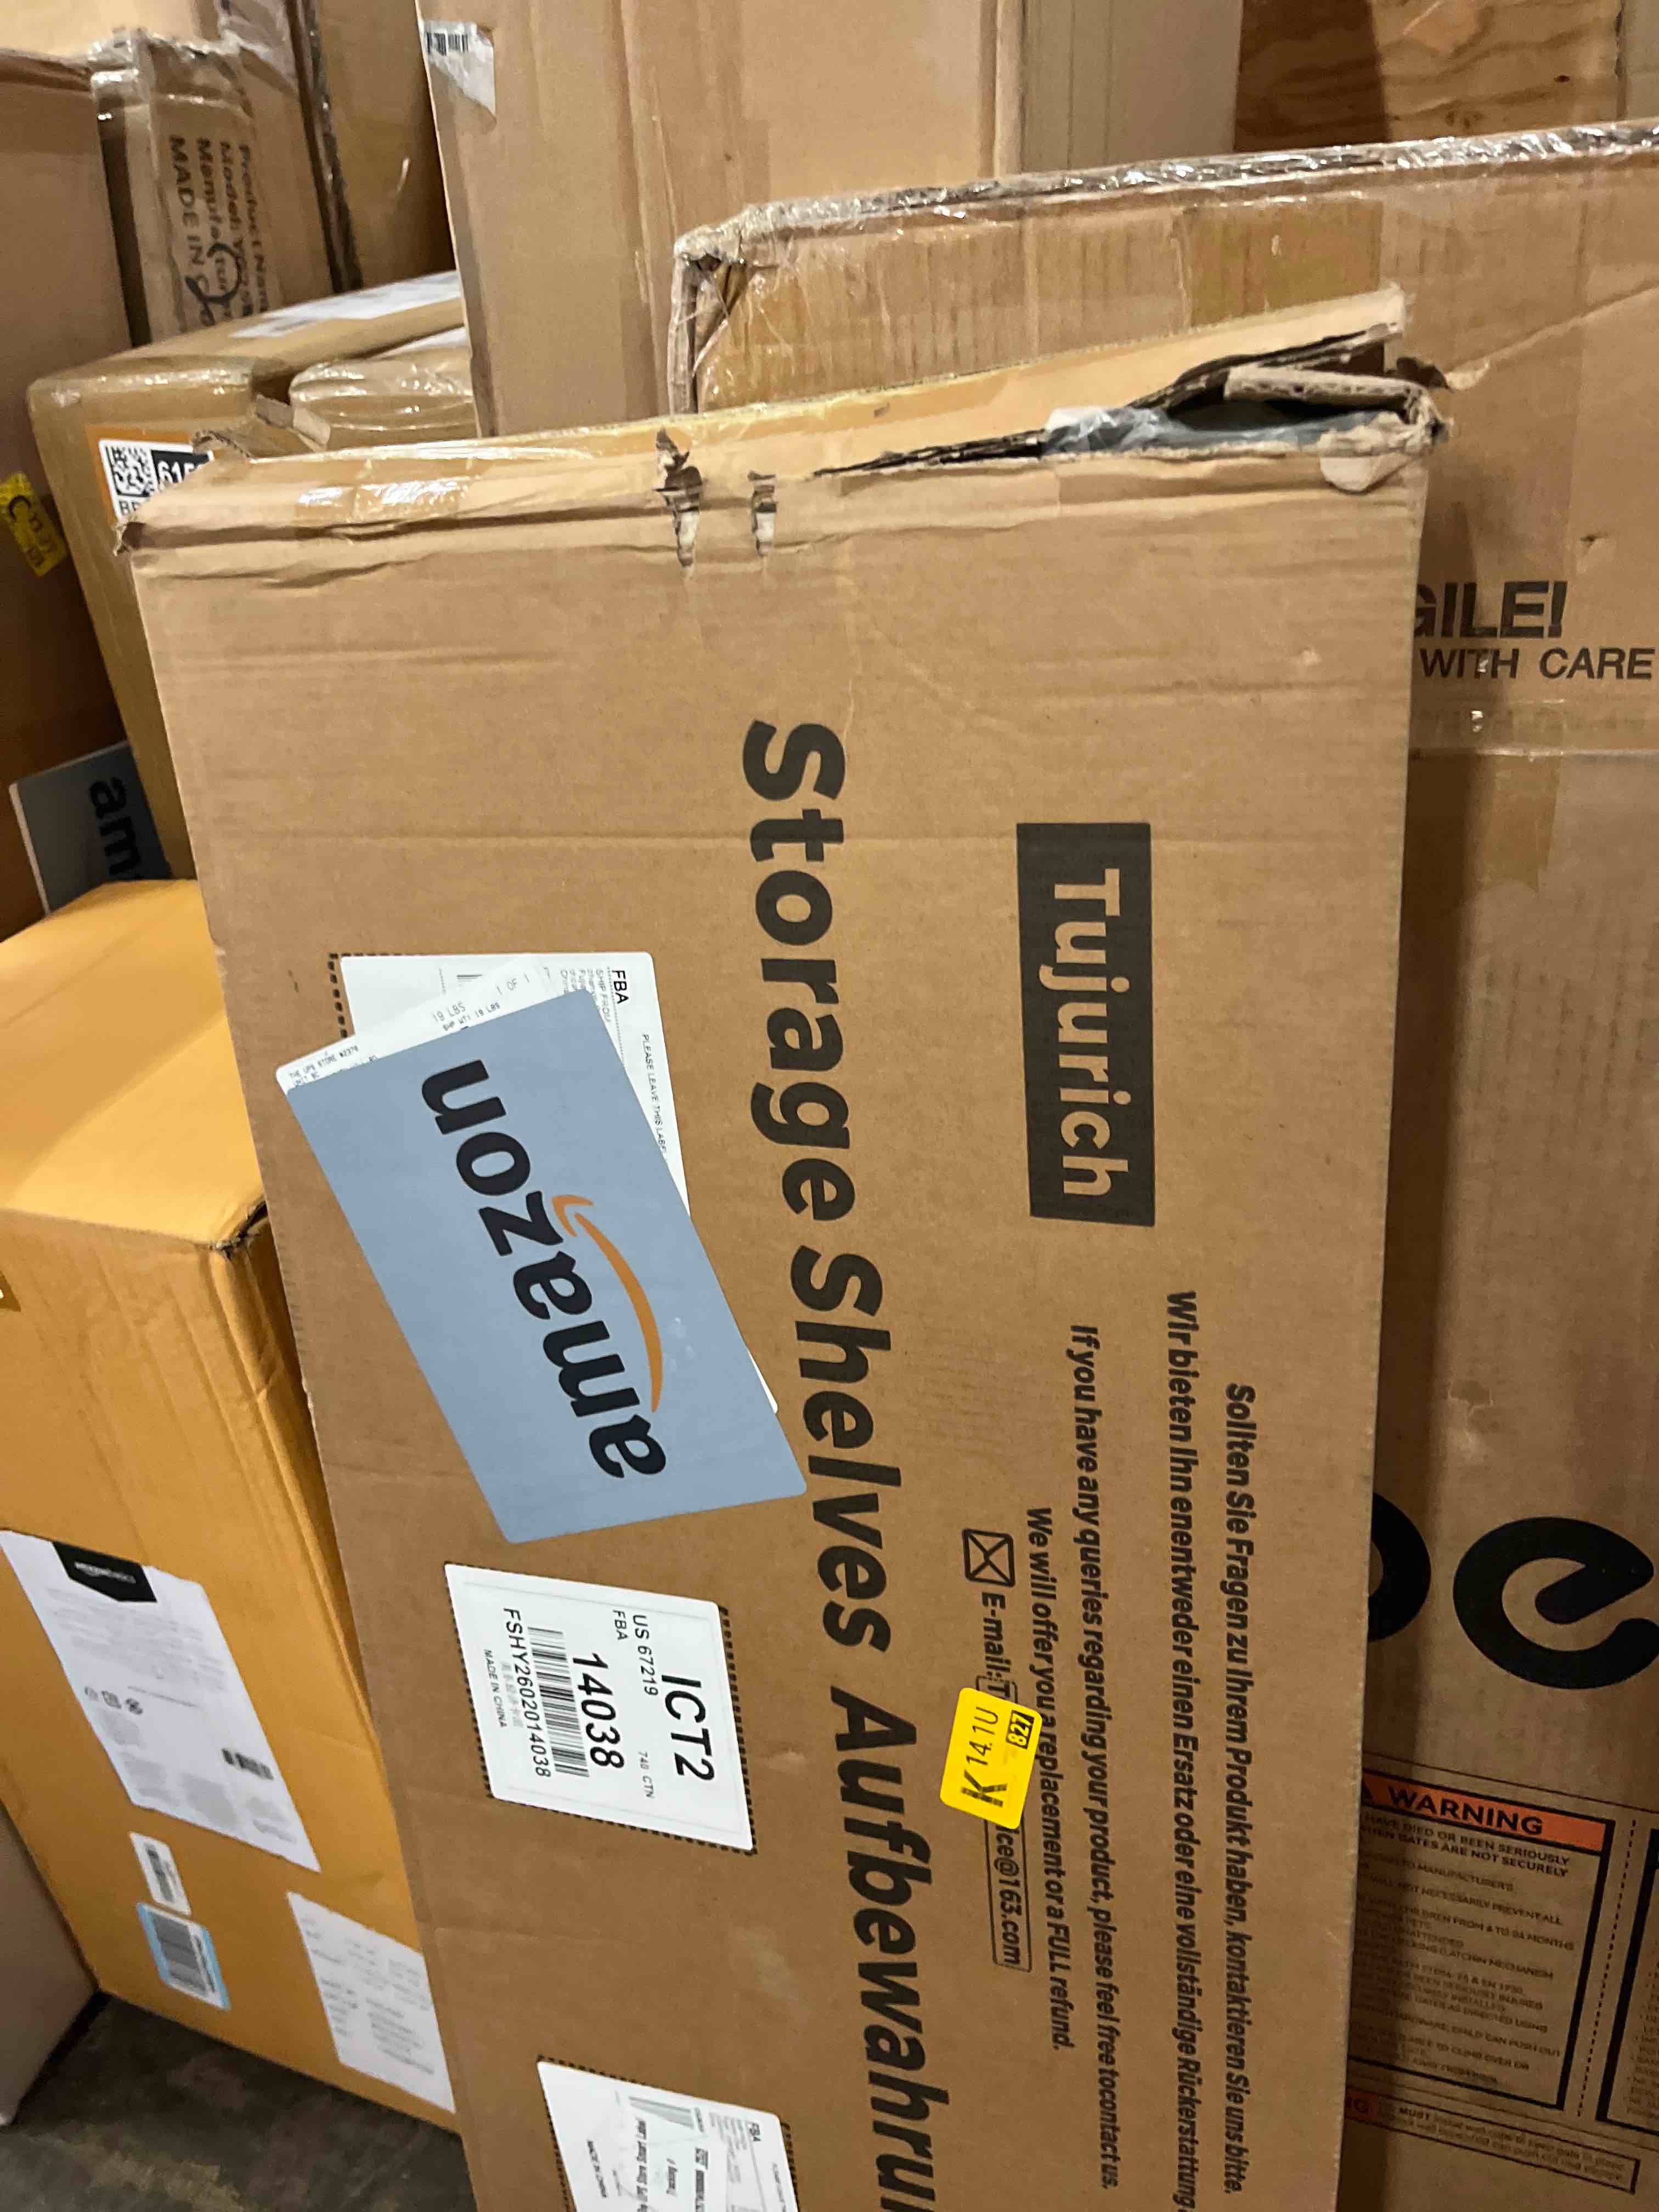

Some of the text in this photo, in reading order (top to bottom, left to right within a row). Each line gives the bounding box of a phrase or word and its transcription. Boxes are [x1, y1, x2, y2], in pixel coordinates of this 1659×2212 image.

[168, 135, 206, 266] MADE IN
[1420, 647, 1656, 680] WITH CARE
[89, 776, 145, 881] am
[506, 978, 518, 991] OF
[612, 970, 629, 1004] FBA
[743, 720, 855, 1221] Storage
[642, 1034, 654, 1070] PLEASE
[1039, 868, 1131, 1198] Tujurich
[648, 1073, 659, 1101] LEAVE
[652, 1105, 663, 1126] THIS
[422, 1059, 667, 1479] amazon
[1071, 1325, 1101, 1350] If
[1167, 1291, 1200, 1345] Wir
[1066, 1348, 1097, 1401] you
[1169, 1348, 1200, 1441] bieten
[790, 1245, 902, 1652] Shelves
[1074, 1408, 1103, 1472] have
[1226, 1383, 1256, 1486] Sollten
[1170, 1447, 1199, 1492] Ihn
[1027, 1507, 1053, 1547] We
[1072, 1476, 1100, 1526] any
[1226, 1491, 1256, 1533] Sie
[1030, 1552, 1057, 1600] will
[1073, 1528, 1109, 1624] queries
[1220, 1537, 1254, 1629] Fragen
[612, 1610, 627, 1640] FBA
[1031, 1603, 1058, 1664] offer
[1226, 1633, 1249, 1663] zu
[633, 1615, 659, 1696] US 67219
[484, 1650, 507, 1728] MADE IN CHINA
[503, 1608, 551, 1778] FSHY2602014038
[573, 1652, 625, 1768] 14038
[1029, 1664, 1056, 1709] you
[1077, 1629, 1113, 1750] regarding
[1172, 1660, 1201, 1729] einen
[1226, 1668, 1254, 1743] Ihrem
[662, 1674, 715, 1781] ICT2
[1008, 1713, 1032, 1746] 827
[642, 1775, 655, 1798] CTN
[961, 1770, 1007, 1807] K
[1081, 1751, 1109, 1808] your
[1173, 1733, 1199, 1810] Ersatz
[1226, 1747, 1253, 1846] Produkt
[1034, 1733, 1066, 1877] replacement
[1387, 1786, 1544, 1836] WARNING
[1083, 1808, 1116, 1904] product,
[1174, 1813, 1201, 1868] oder
[1437, 1830, 1456, 1842] OR
[1460, 1834, 1494, 1850] BEEN
[1498, 1843, 1570, 1866] SERIOUSLY
[1441, 1842, 1468, 1857] ARE
[1471, 1849, 1499, 1863] NOT
[1501, 1854, 1569, 1877] SECURELY
[1045, 1880, 1064, 1905] or
[1046, 1905, 1063, 1920] a
[1175, 1870, 1203, 1919] eine
[1224, 1849, 1254, 1926] haben,
[1047, 1922, 1070, 1972] FULL
[1087, 1906, 1117, 1982] please
[1050, 1976, 1075, 2050] refund.
[1096, 1982, 1121, 2023] feel
[1171, 1923, 1203, 2055] vollständige
[1226, 1931, 1253, 2069] kontaktieren
[1097, 2024, 1121, 2067] free
[1225, 2073, 1251, 2104] Sie
[1172, 2058, 1203, 2209] Rückerstattung
[1225, 2106, 1245, 2142] uns
